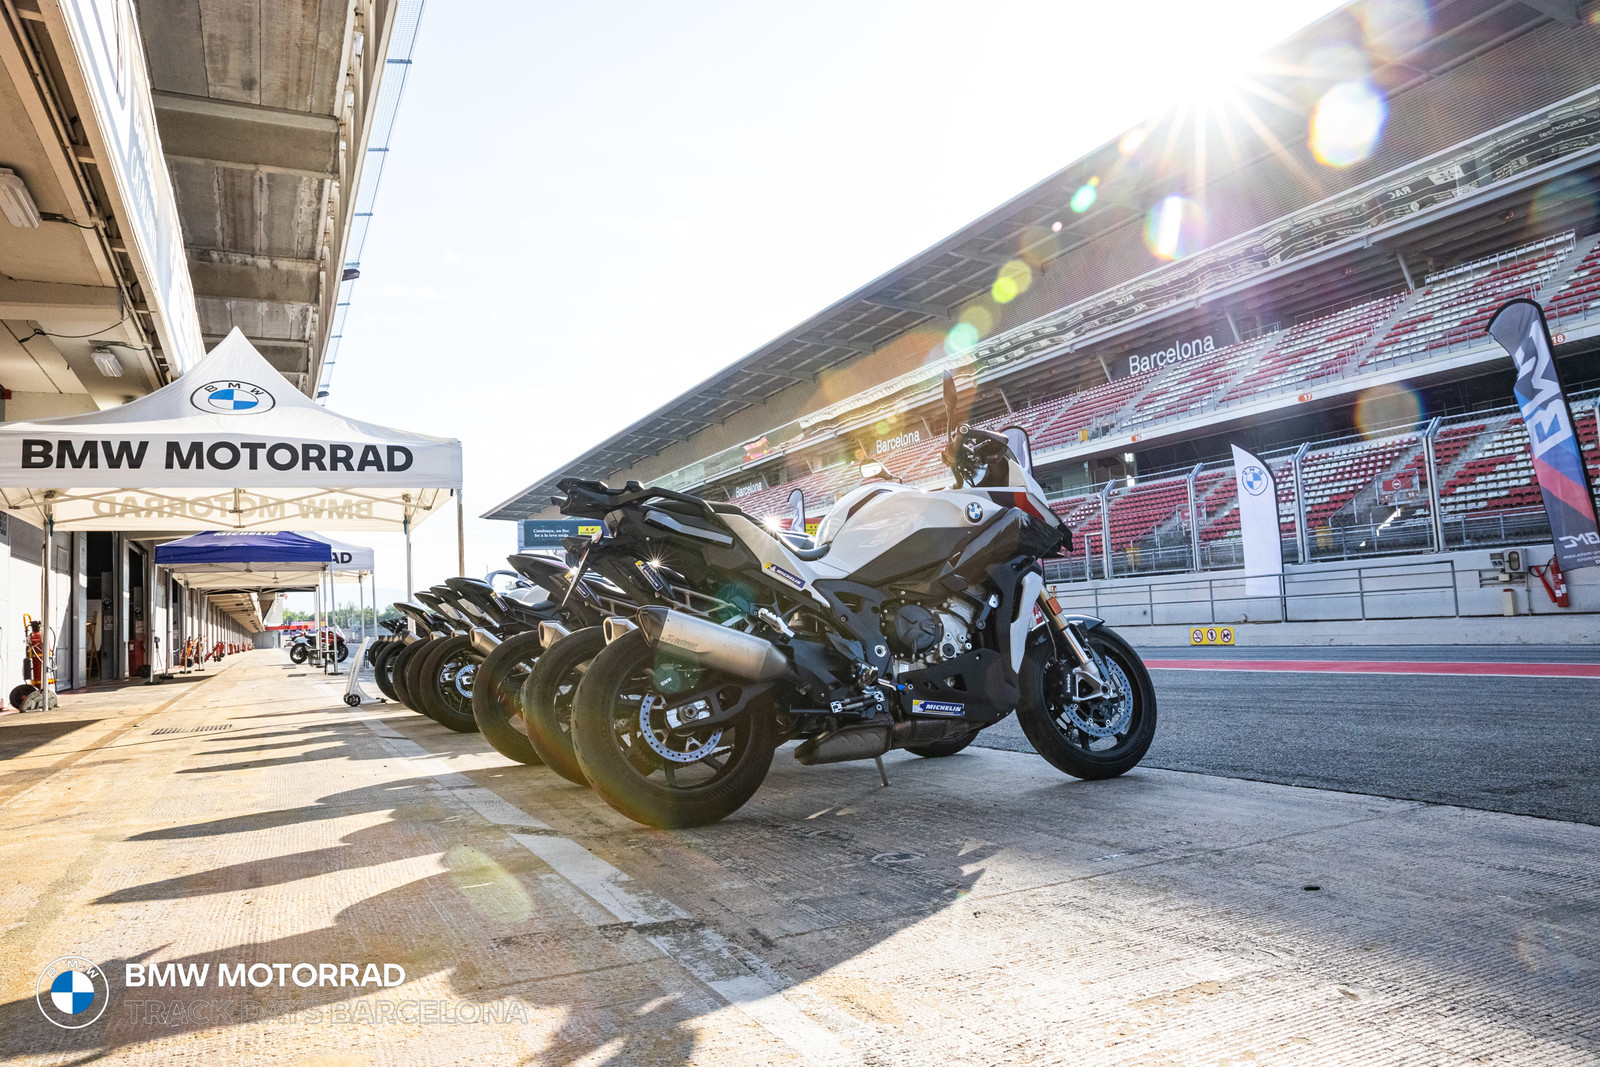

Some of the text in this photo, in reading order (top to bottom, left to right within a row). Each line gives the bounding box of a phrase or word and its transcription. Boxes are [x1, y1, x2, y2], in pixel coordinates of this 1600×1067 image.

[1129, 335, 1215, 375] Barcelona
[204, 382, 264, 396] BMW
[876, 430, 920, 454] Barcelona
[21, 438, 413, 472] BMW MOTORRAD
[735, 481, 763, 498] Barcelona
[776, 568, 802, 585] MICHELIN
[925, 703, 962, 712] MICHELIN
